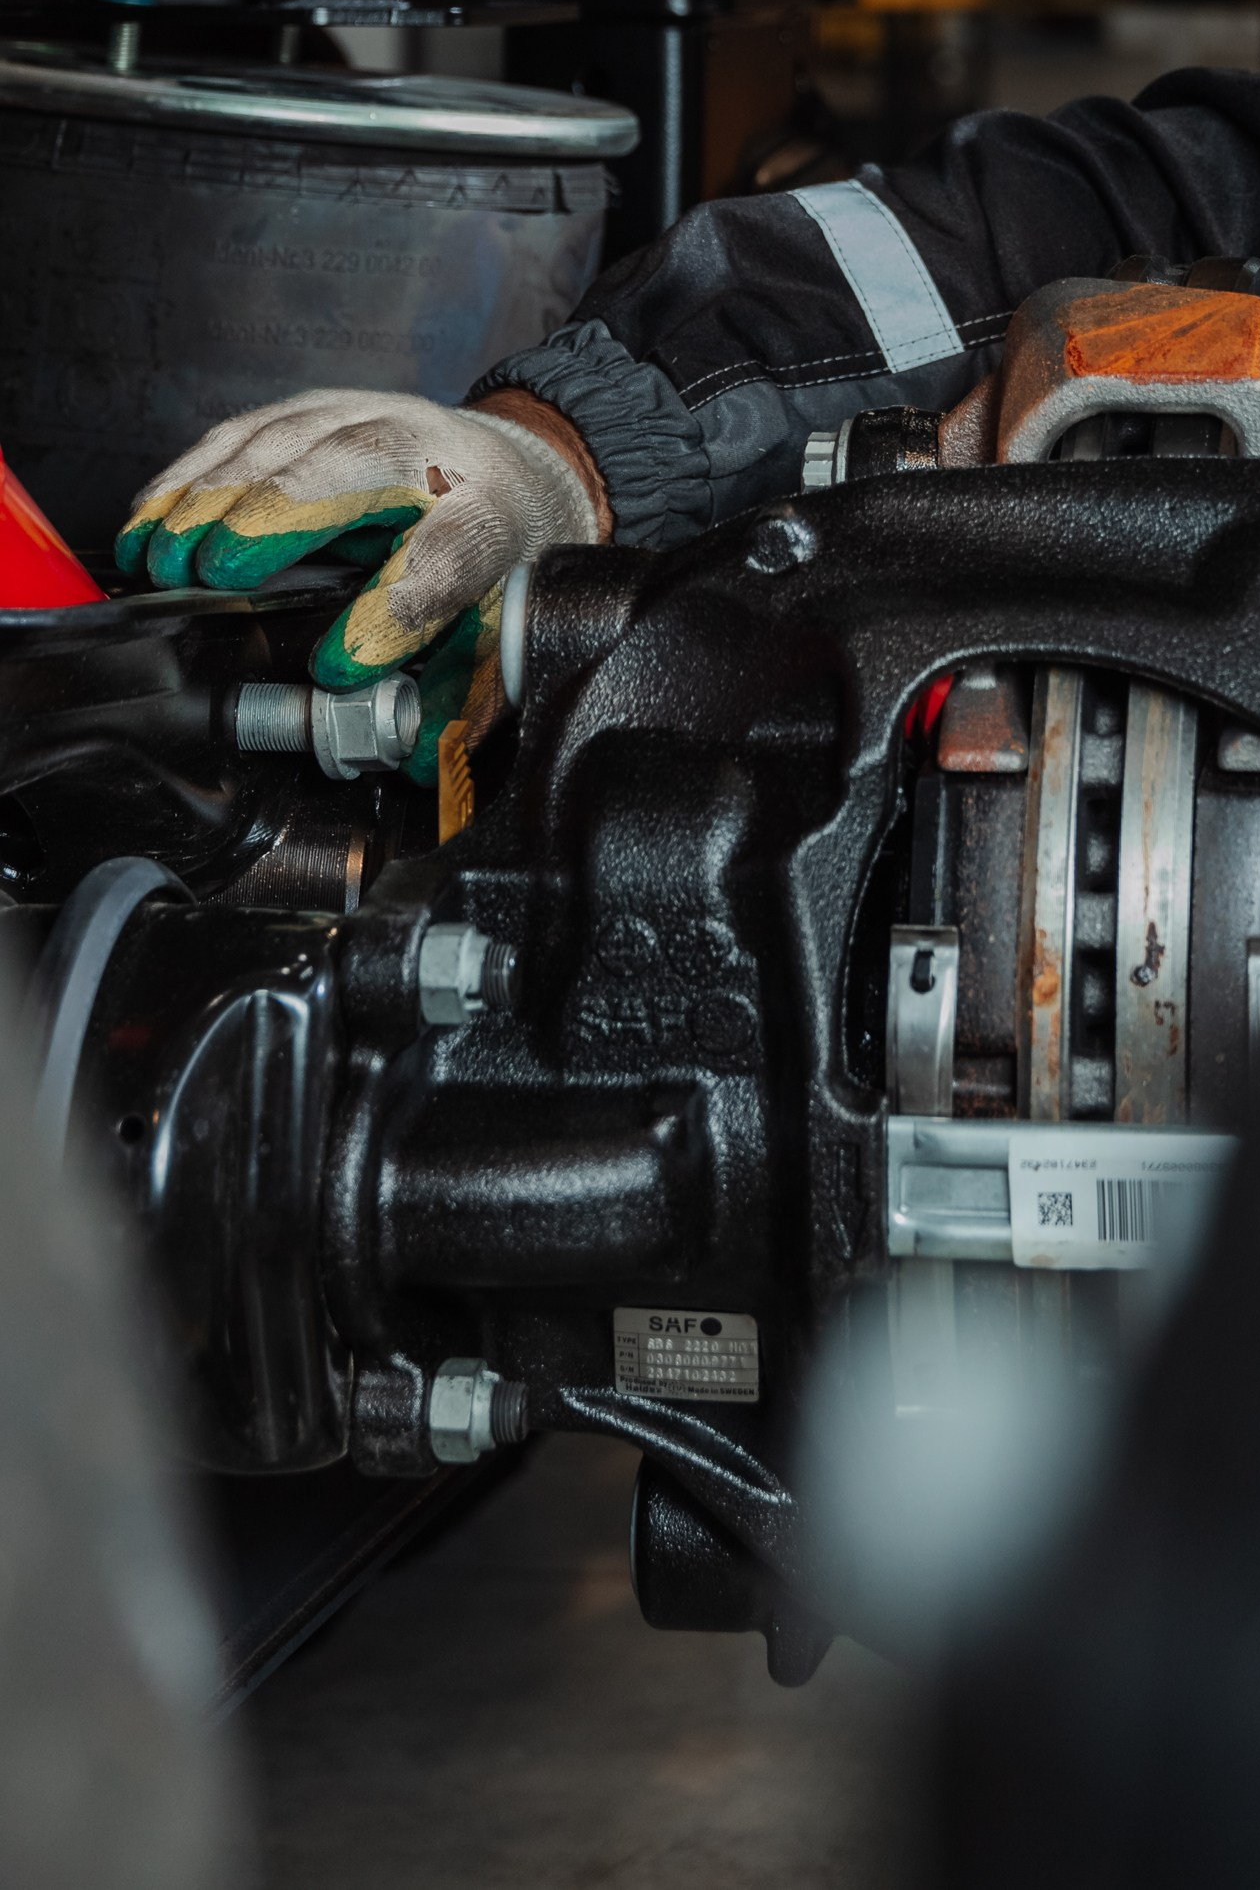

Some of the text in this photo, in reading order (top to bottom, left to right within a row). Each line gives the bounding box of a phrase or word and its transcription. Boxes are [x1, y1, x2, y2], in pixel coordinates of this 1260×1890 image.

[320, 248, 359, 273] 229
[648, 1315, 698, 1334] SAF
[617, 1335, 637, 1346] TYPE
[687, 1385, 709, 1395] Made
[719, 1387, 755, 1397] SWEDEN
